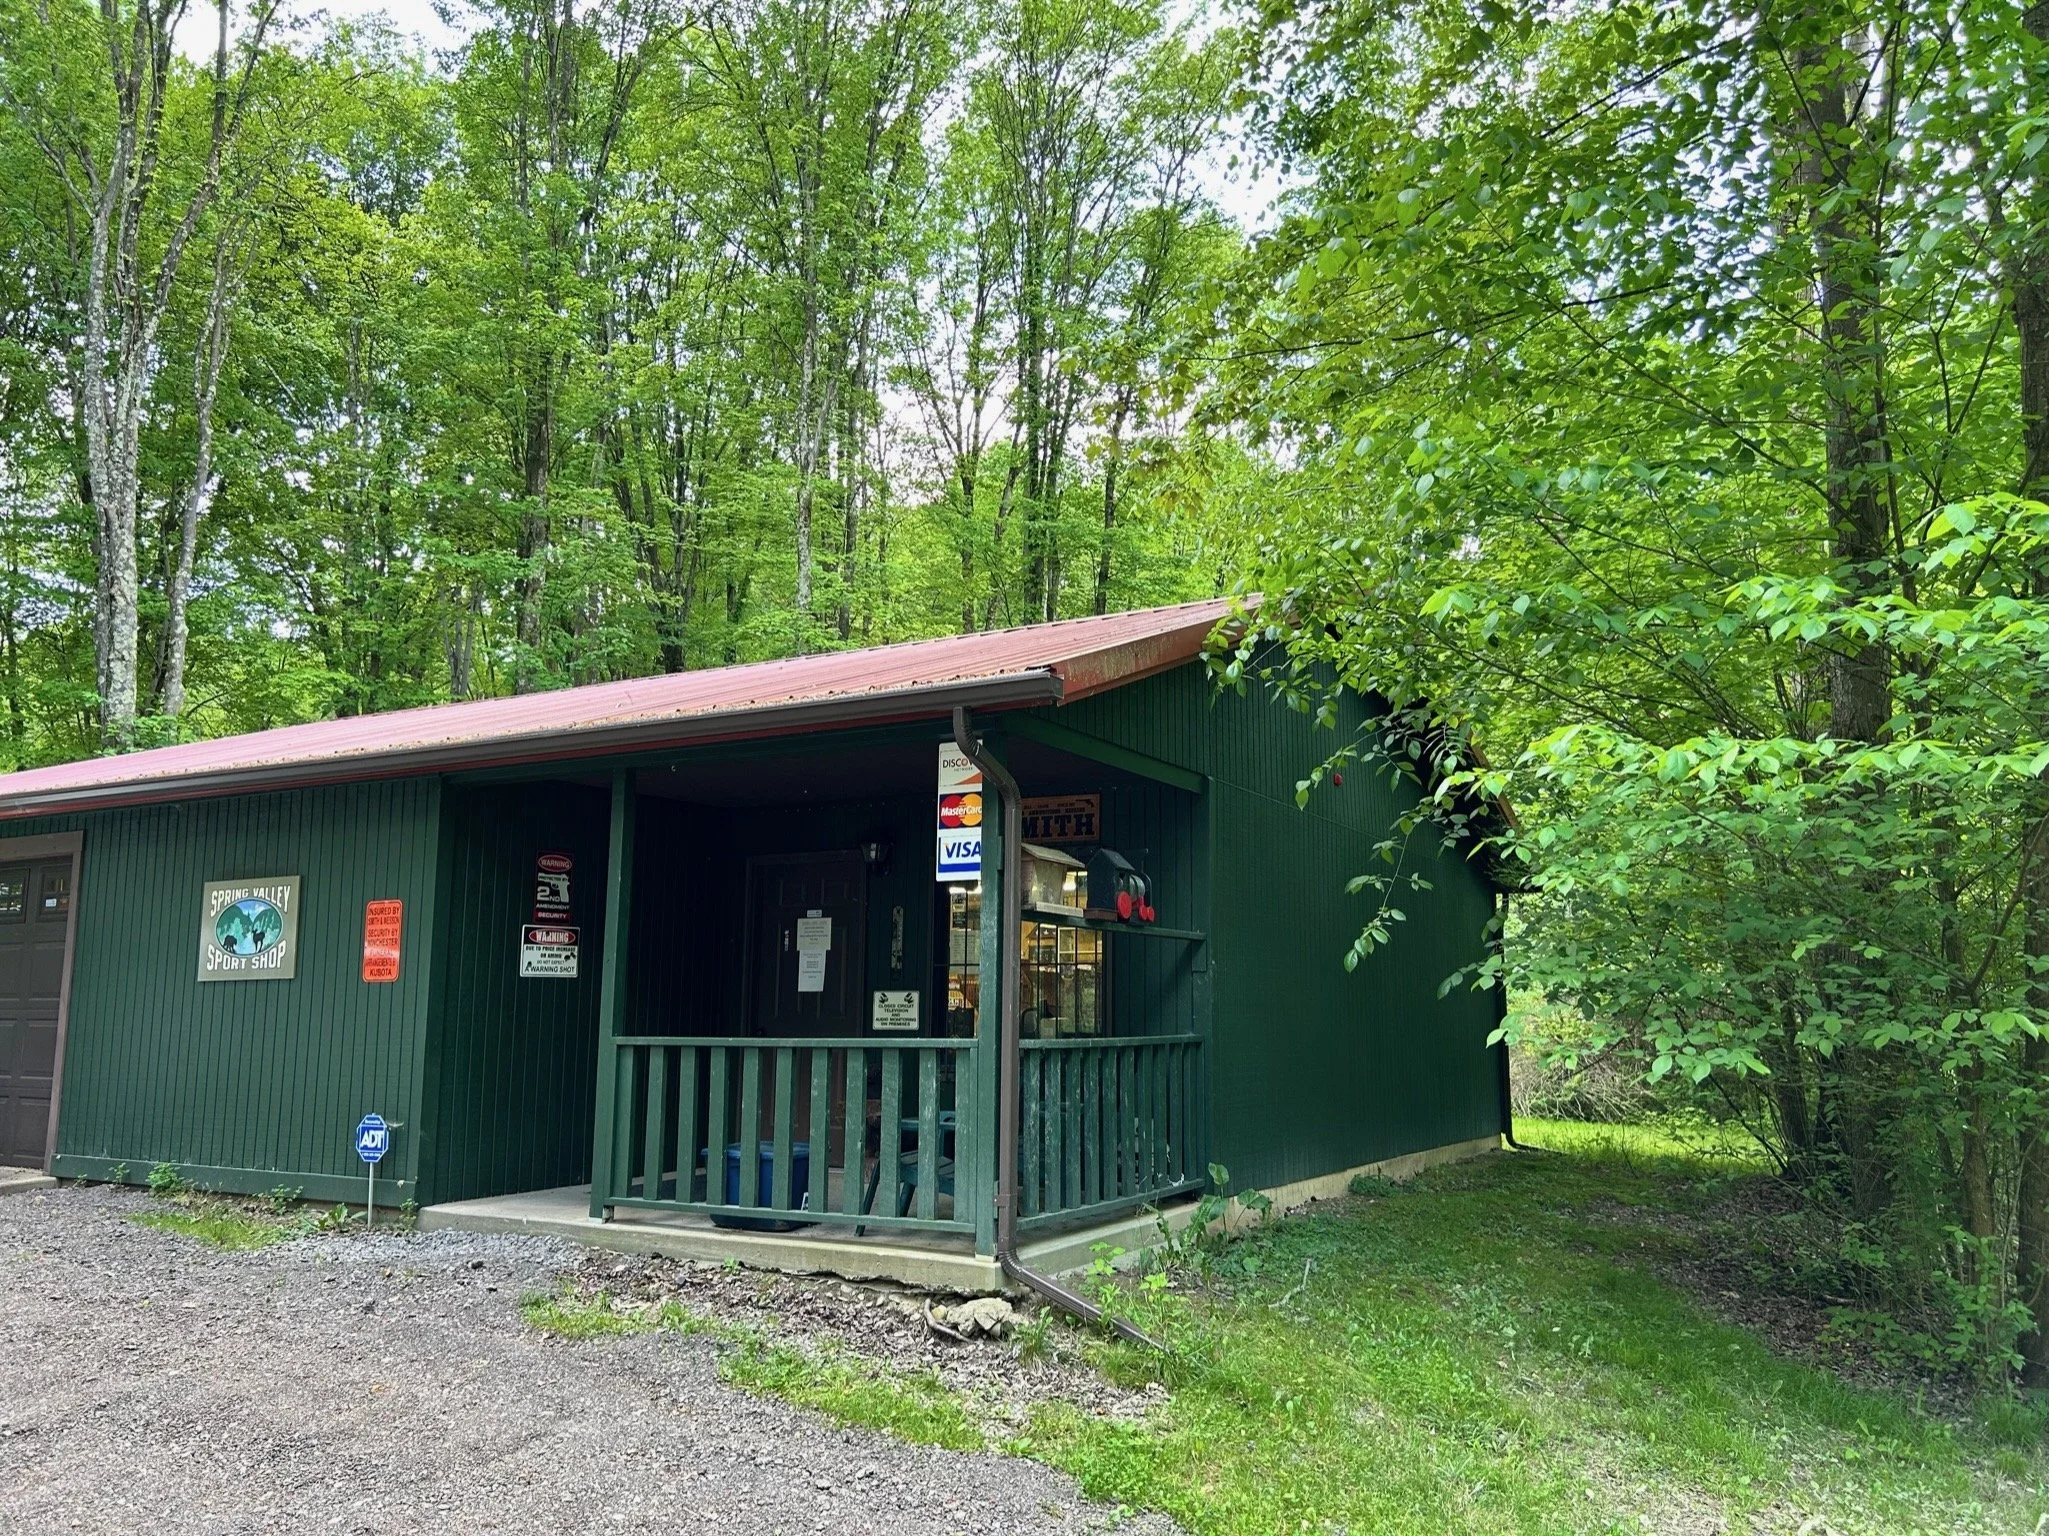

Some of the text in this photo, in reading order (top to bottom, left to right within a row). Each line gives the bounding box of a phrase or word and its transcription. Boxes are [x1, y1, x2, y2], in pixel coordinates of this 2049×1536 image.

[1021, 813, 1095, 838] MITH
[945, 840, 981, 859] VISA
[541, 859, 570, 869] WARNING
[210, 885, 291, 917] SPRING VALLEY
[368, 906, 400, 916] INSURED BY
[537, 911, 568, 919] SECURITY
[384, 916, 399, 925] WESSON
[368, 928, 398, 937] SECURITY BY
[535, 930, 569, 943] WARNING
[367, 938, 397, 947] WINCHESTER
[206, 940, 287, 971] SPORT SHOP
[369, 968, 392, 977] KUBOTA
[360, 1130, 384, 1148] ADT
